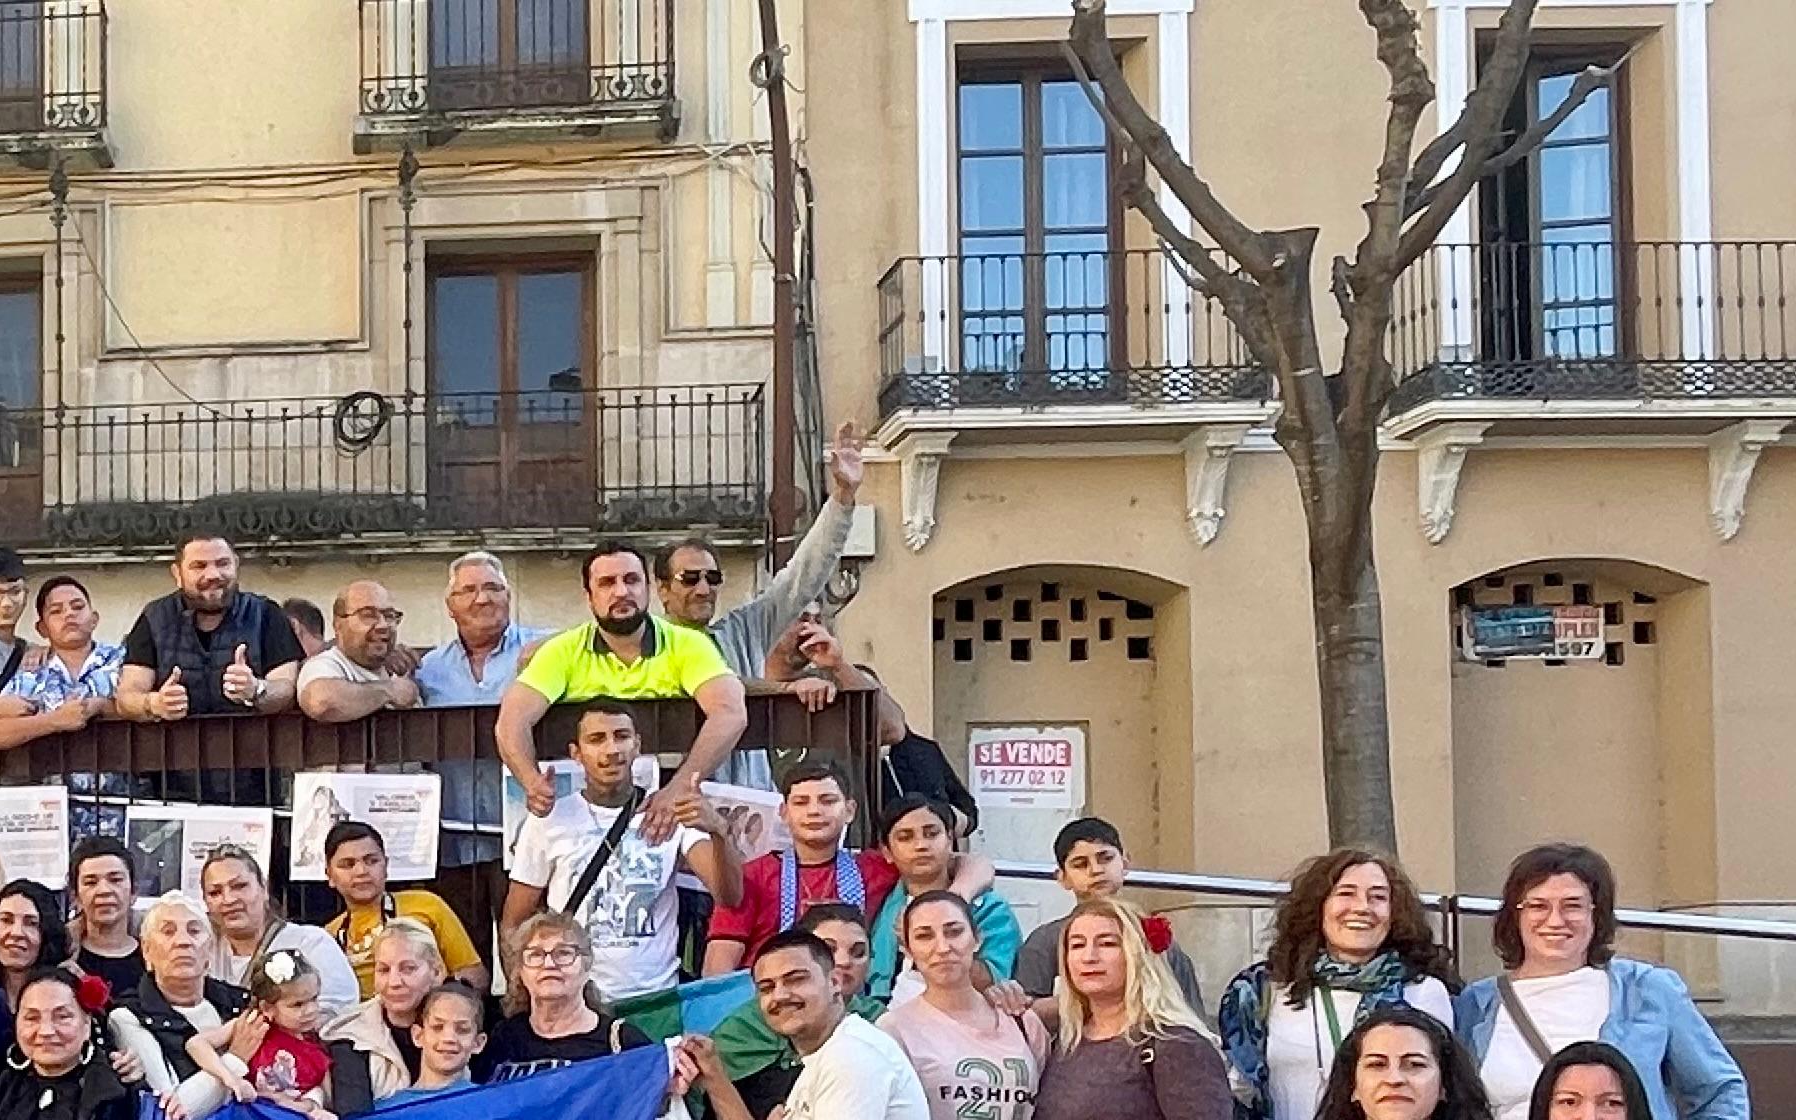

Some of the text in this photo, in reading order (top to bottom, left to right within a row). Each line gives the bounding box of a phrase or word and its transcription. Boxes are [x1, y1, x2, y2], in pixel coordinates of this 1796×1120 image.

[980, 741, 1067, 765] SE VENDE
[980, 769, 1066, 785] 91 277 02 12
